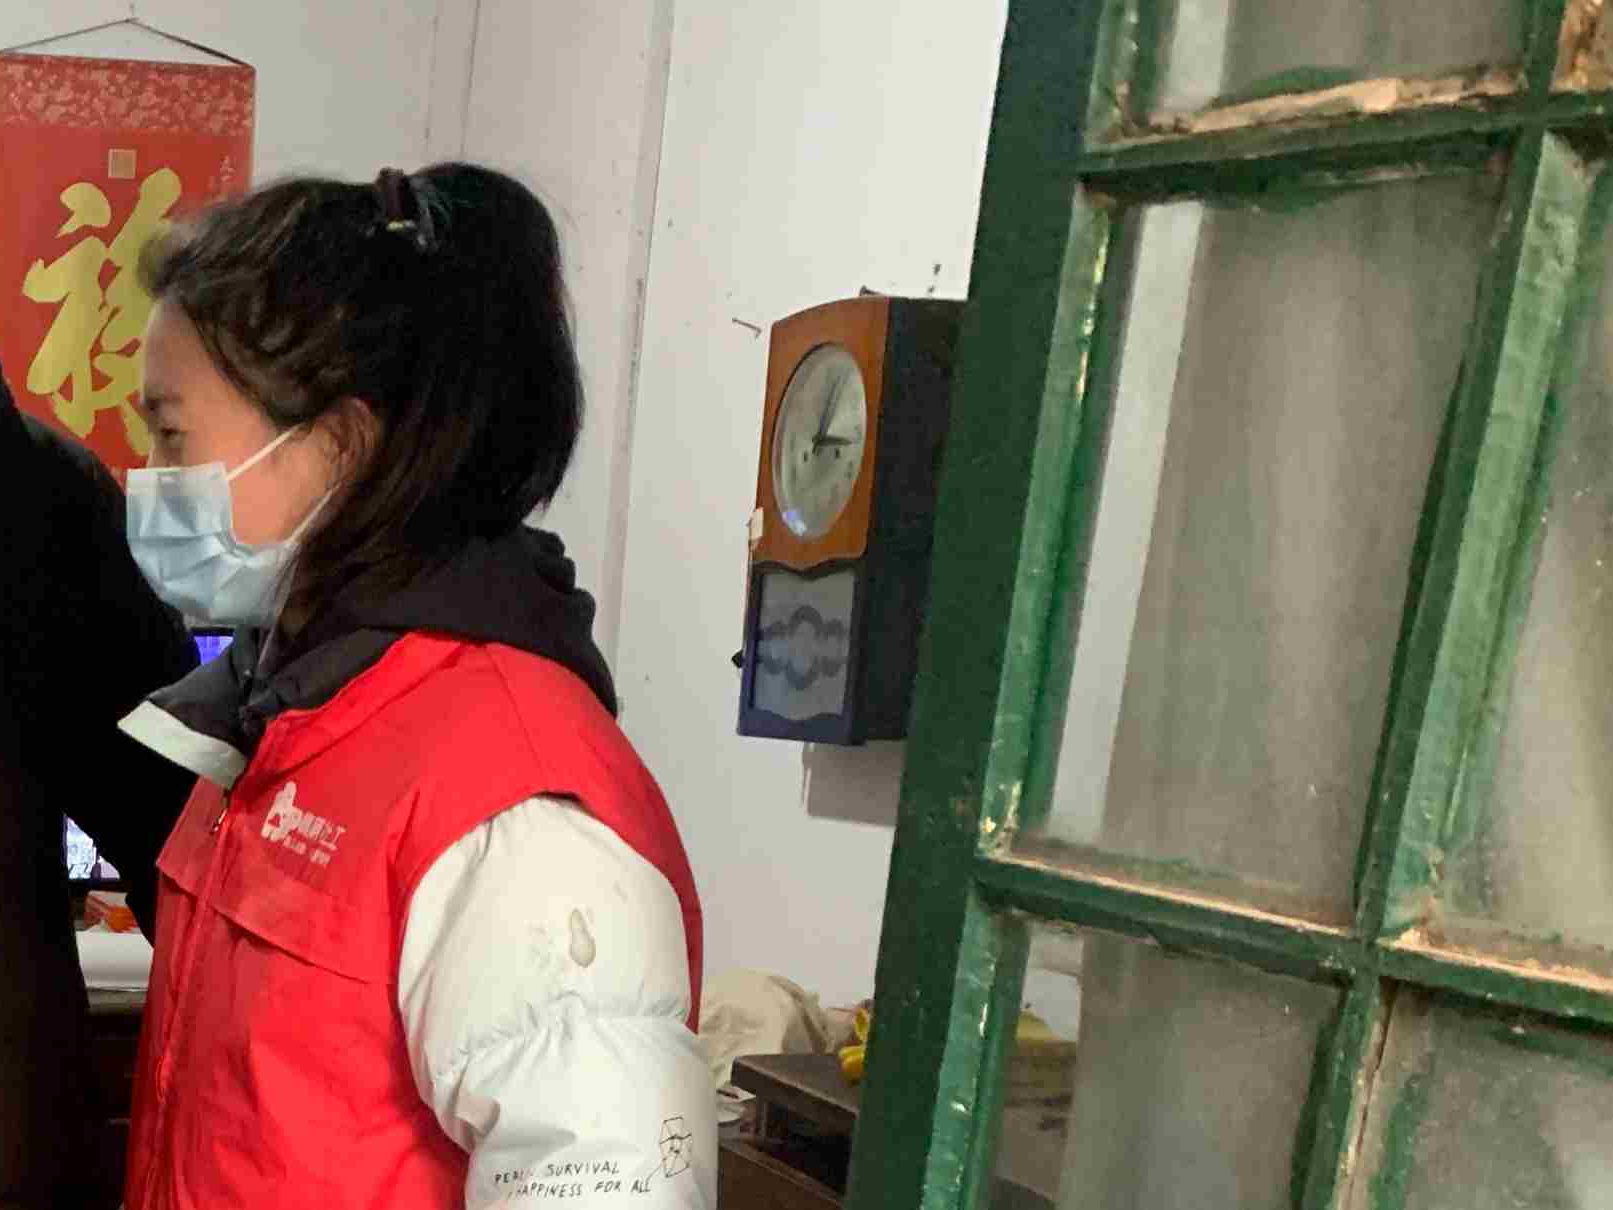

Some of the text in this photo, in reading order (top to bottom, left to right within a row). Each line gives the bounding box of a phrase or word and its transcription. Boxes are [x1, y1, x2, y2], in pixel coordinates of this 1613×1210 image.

[547, 1161, 620, 1176] SURVIVAL
[594, 1181, 621, 1192] FOR
[630, 1179, 651, 1193] ALL
